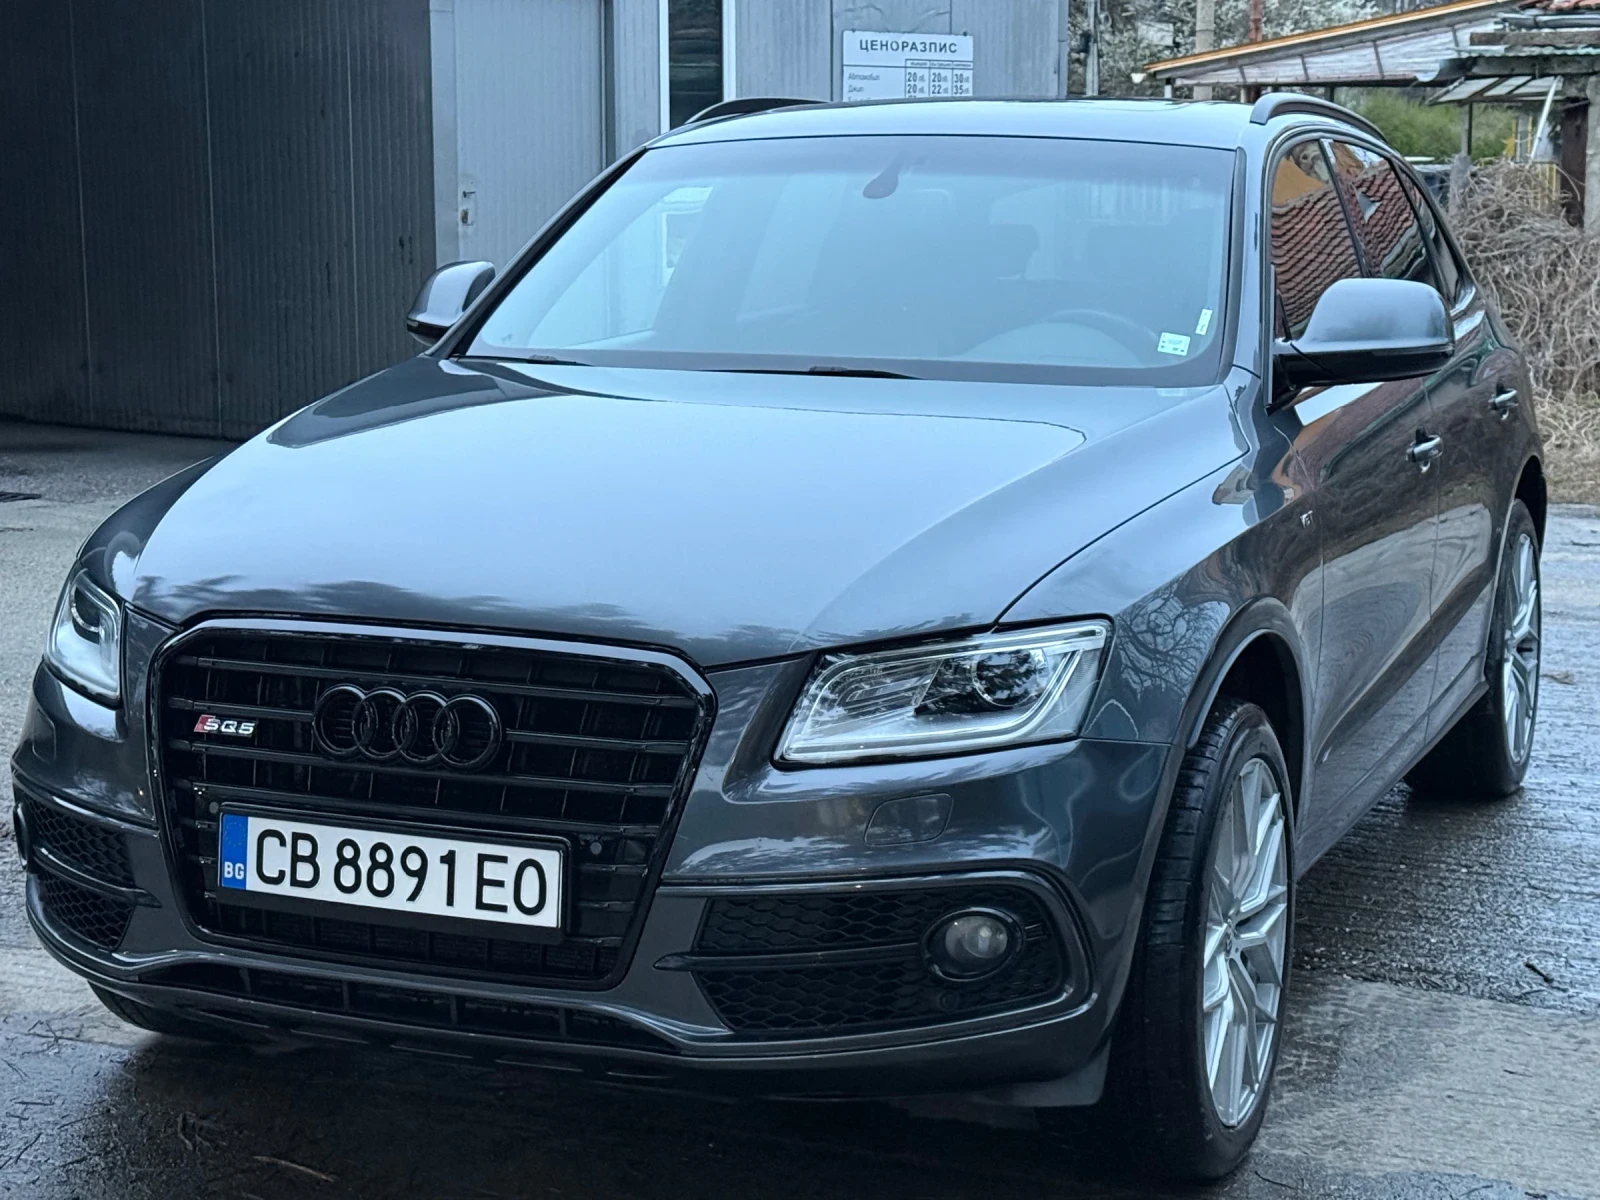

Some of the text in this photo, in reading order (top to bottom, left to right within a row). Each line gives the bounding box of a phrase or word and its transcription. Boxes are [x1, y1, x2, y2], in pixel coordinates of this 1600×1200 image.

[859, 39, 958, 53] ЦЕНОРАЗПИС
[907, 72, 918, 82] 20
[931, 72, 942, 83] 20
[954, 73, 964, 83] 30
[907, 83, 918, 94] 20
[931, 84, 942, 94] 22
[953, 84, 964, 95] 35
[203, 718, 256, 735] SQ5
[223, 861, 245, 880] BG
[255, 828, 321, 889] CB
[333, 837, 457, 907] 8891
